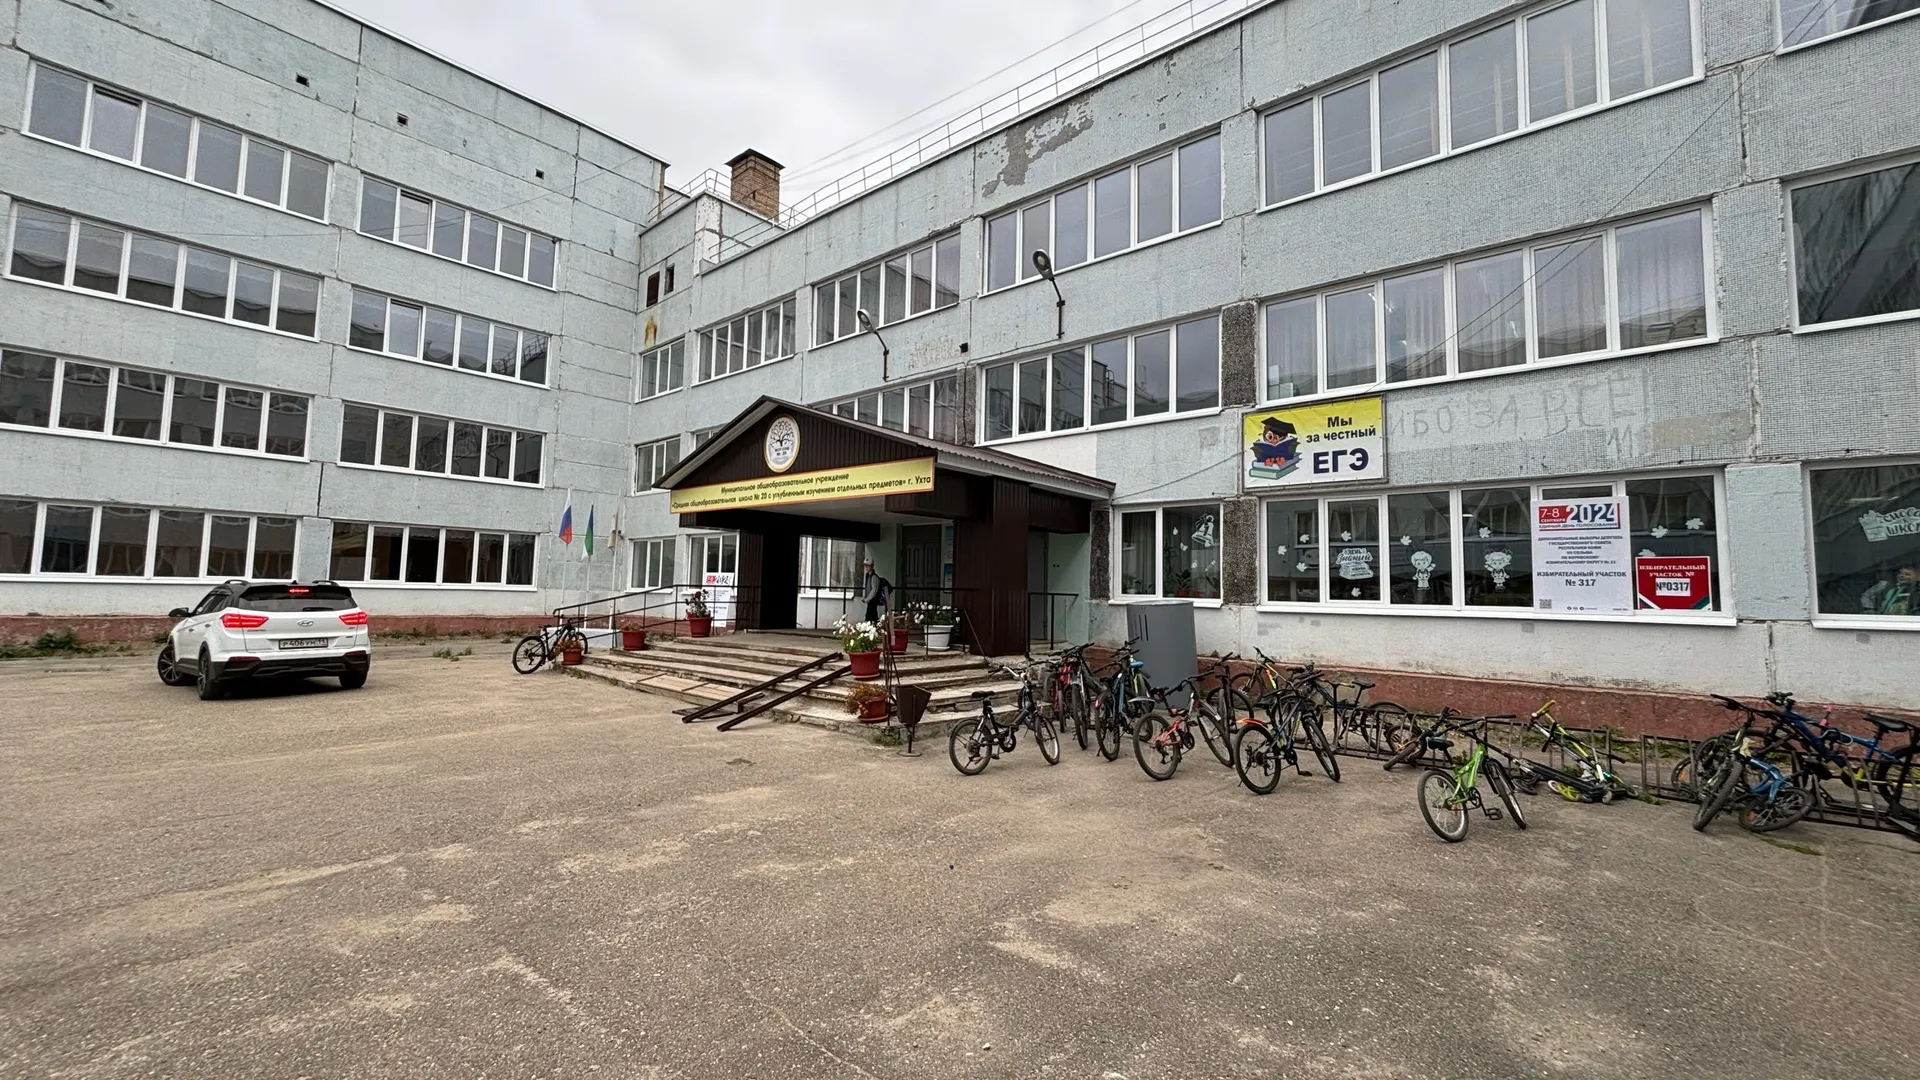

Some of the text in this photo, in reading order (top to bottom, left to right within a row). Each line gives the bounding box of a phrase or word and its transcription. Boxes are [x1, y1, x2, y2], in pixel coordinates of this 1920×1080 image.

[1327, 416, 1352, 428] Мы
[1306, 425, 1376, 443] за честный
[1313, 447, 1369, 474] ЕГЭ
[806, 487, 835, 496] изучением
[837, 484, 867, 492] отдельных
[868, 479, 906, 490] предметов»
[915, 475, 931, 484] Ухта
[815, 473, 849, 485] учреждение
[1540, 503, 1617, 523] 7-8 2024
[1565, 579, 1596, 587] № 317
